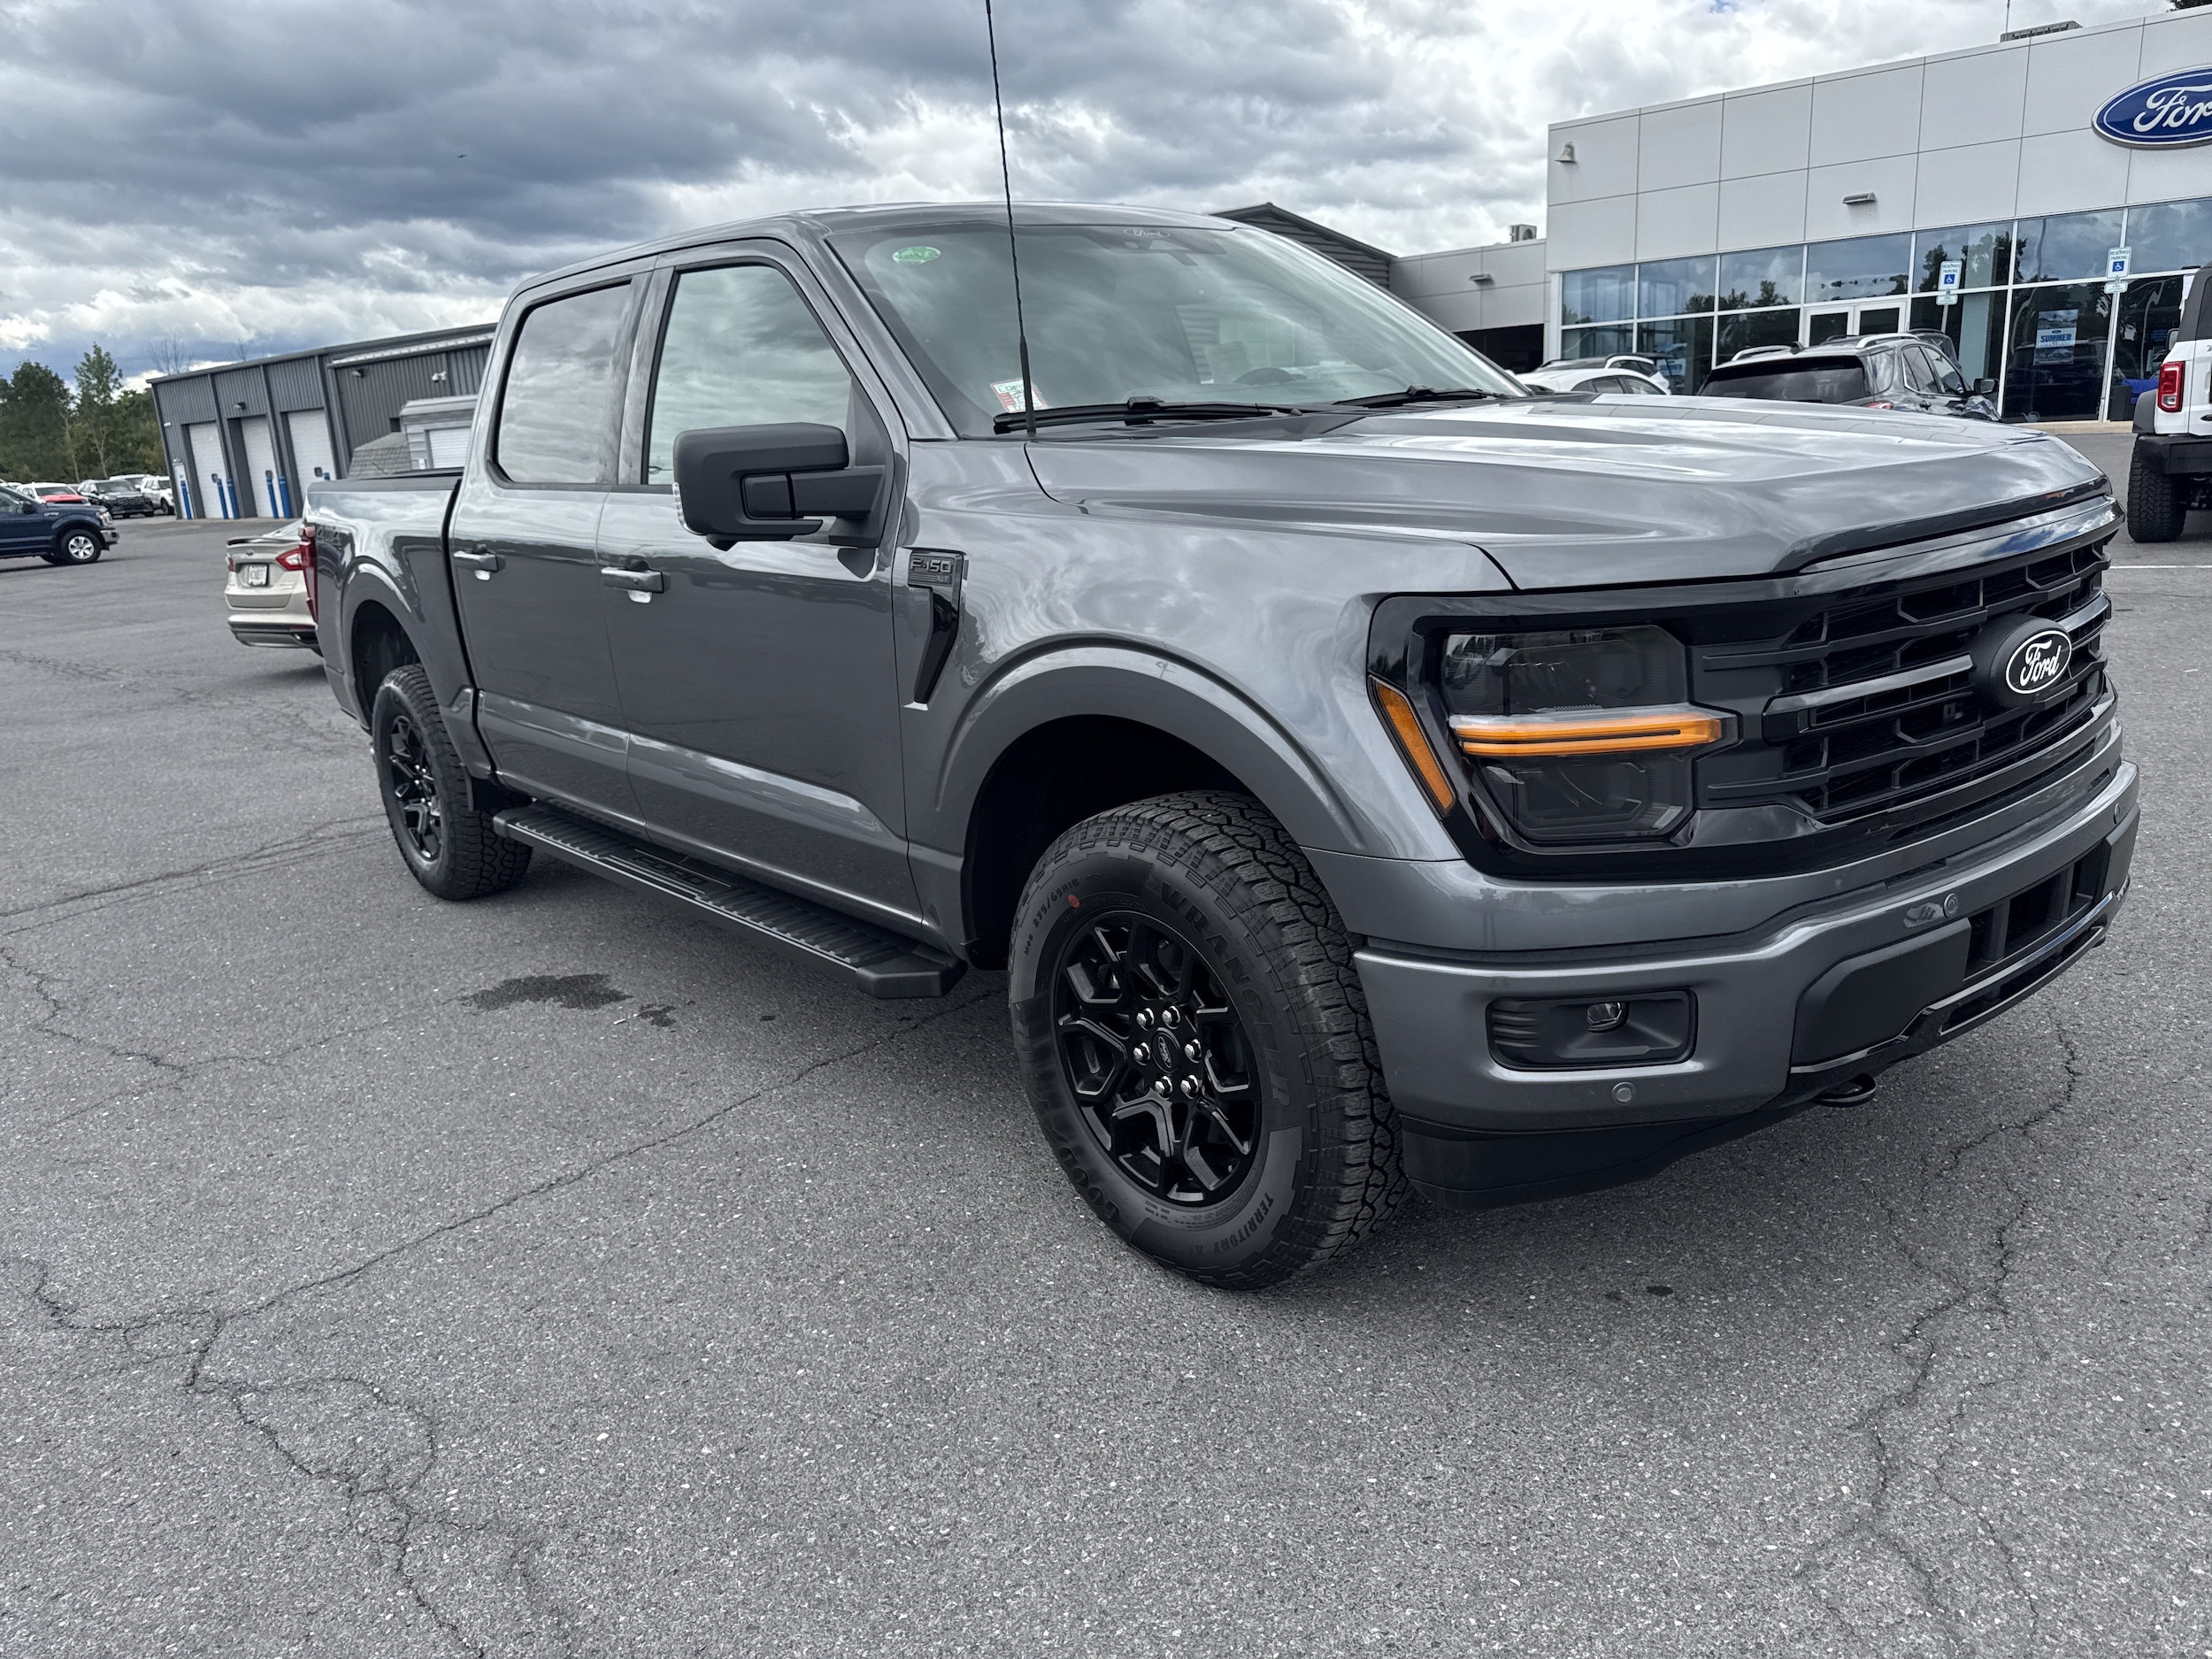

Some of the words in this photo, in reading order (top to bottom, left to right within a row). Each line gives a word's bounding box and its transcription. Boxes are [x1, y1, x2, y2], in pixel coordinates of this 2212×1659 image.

[2040, 334, 2071, 342] SUMMER
[910, 559, 952, 573] F-150
[2019, 639, 2062, 687] Ford
[632, 856, 710, 886] FORD
[1033, 877, 1080, 928] 275/65R18
[1214, 1191, 1275, 1254] TERRITORY
